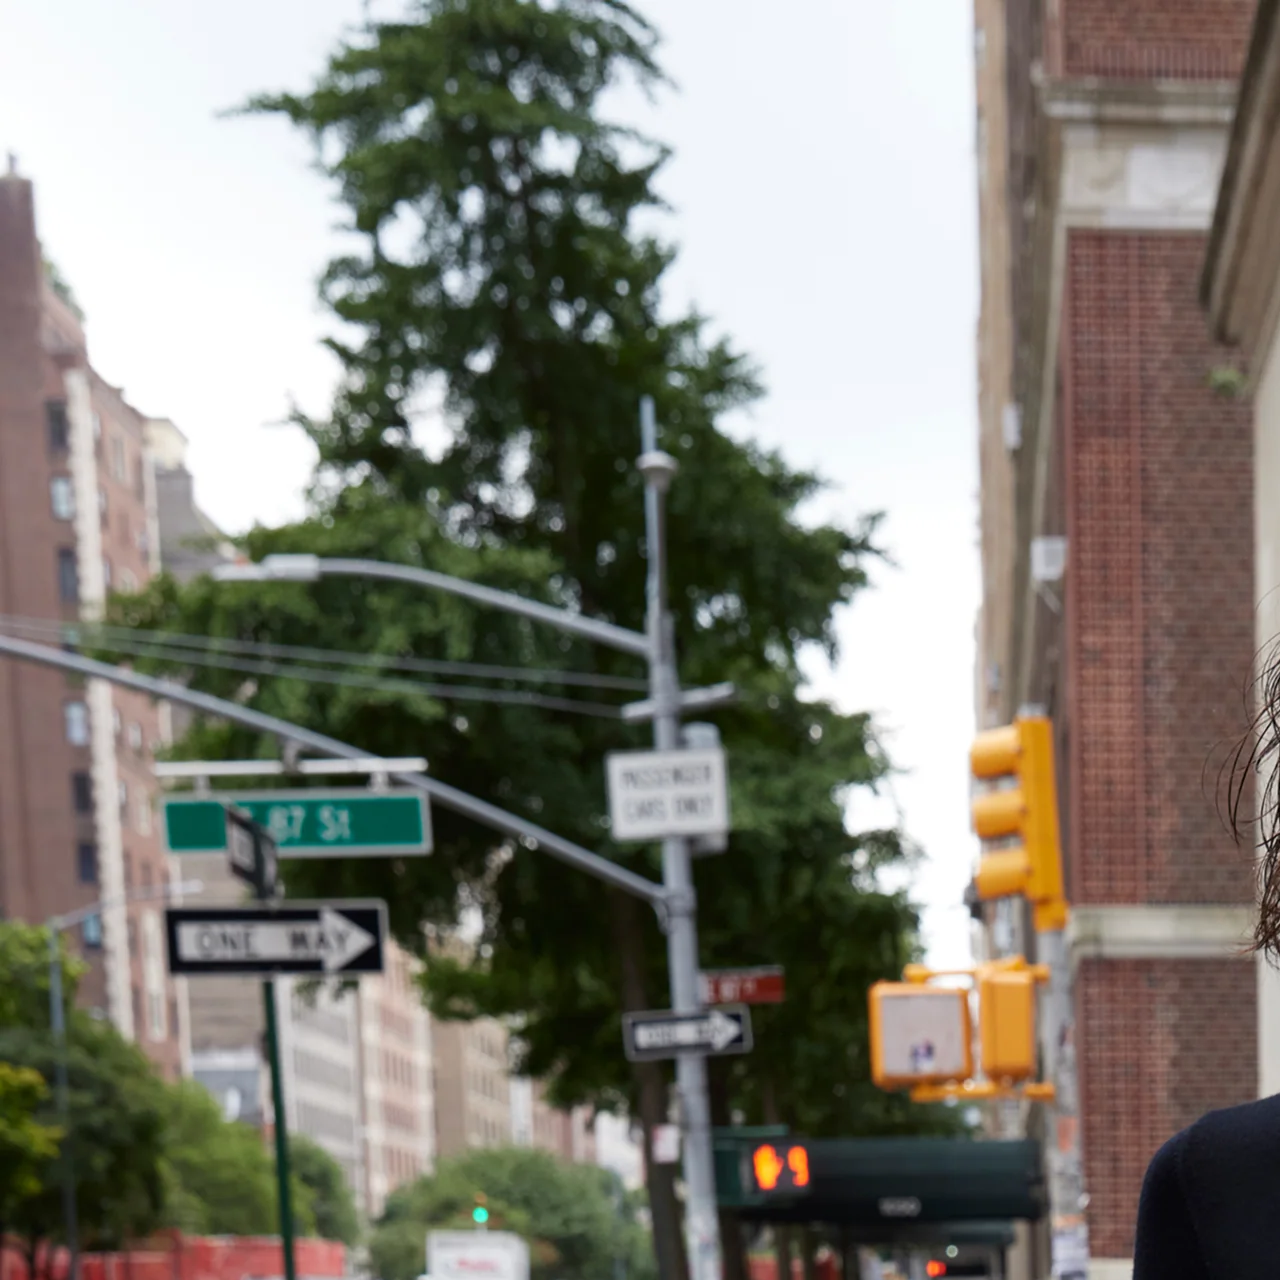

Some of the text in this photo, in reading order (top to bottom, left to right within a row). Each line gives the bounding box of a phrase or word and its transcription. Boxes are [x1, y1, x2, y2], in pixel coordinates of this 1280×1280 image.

[267, 804, 352, 843] 87 St
[195, 922, 353, 958] ONE WAY
